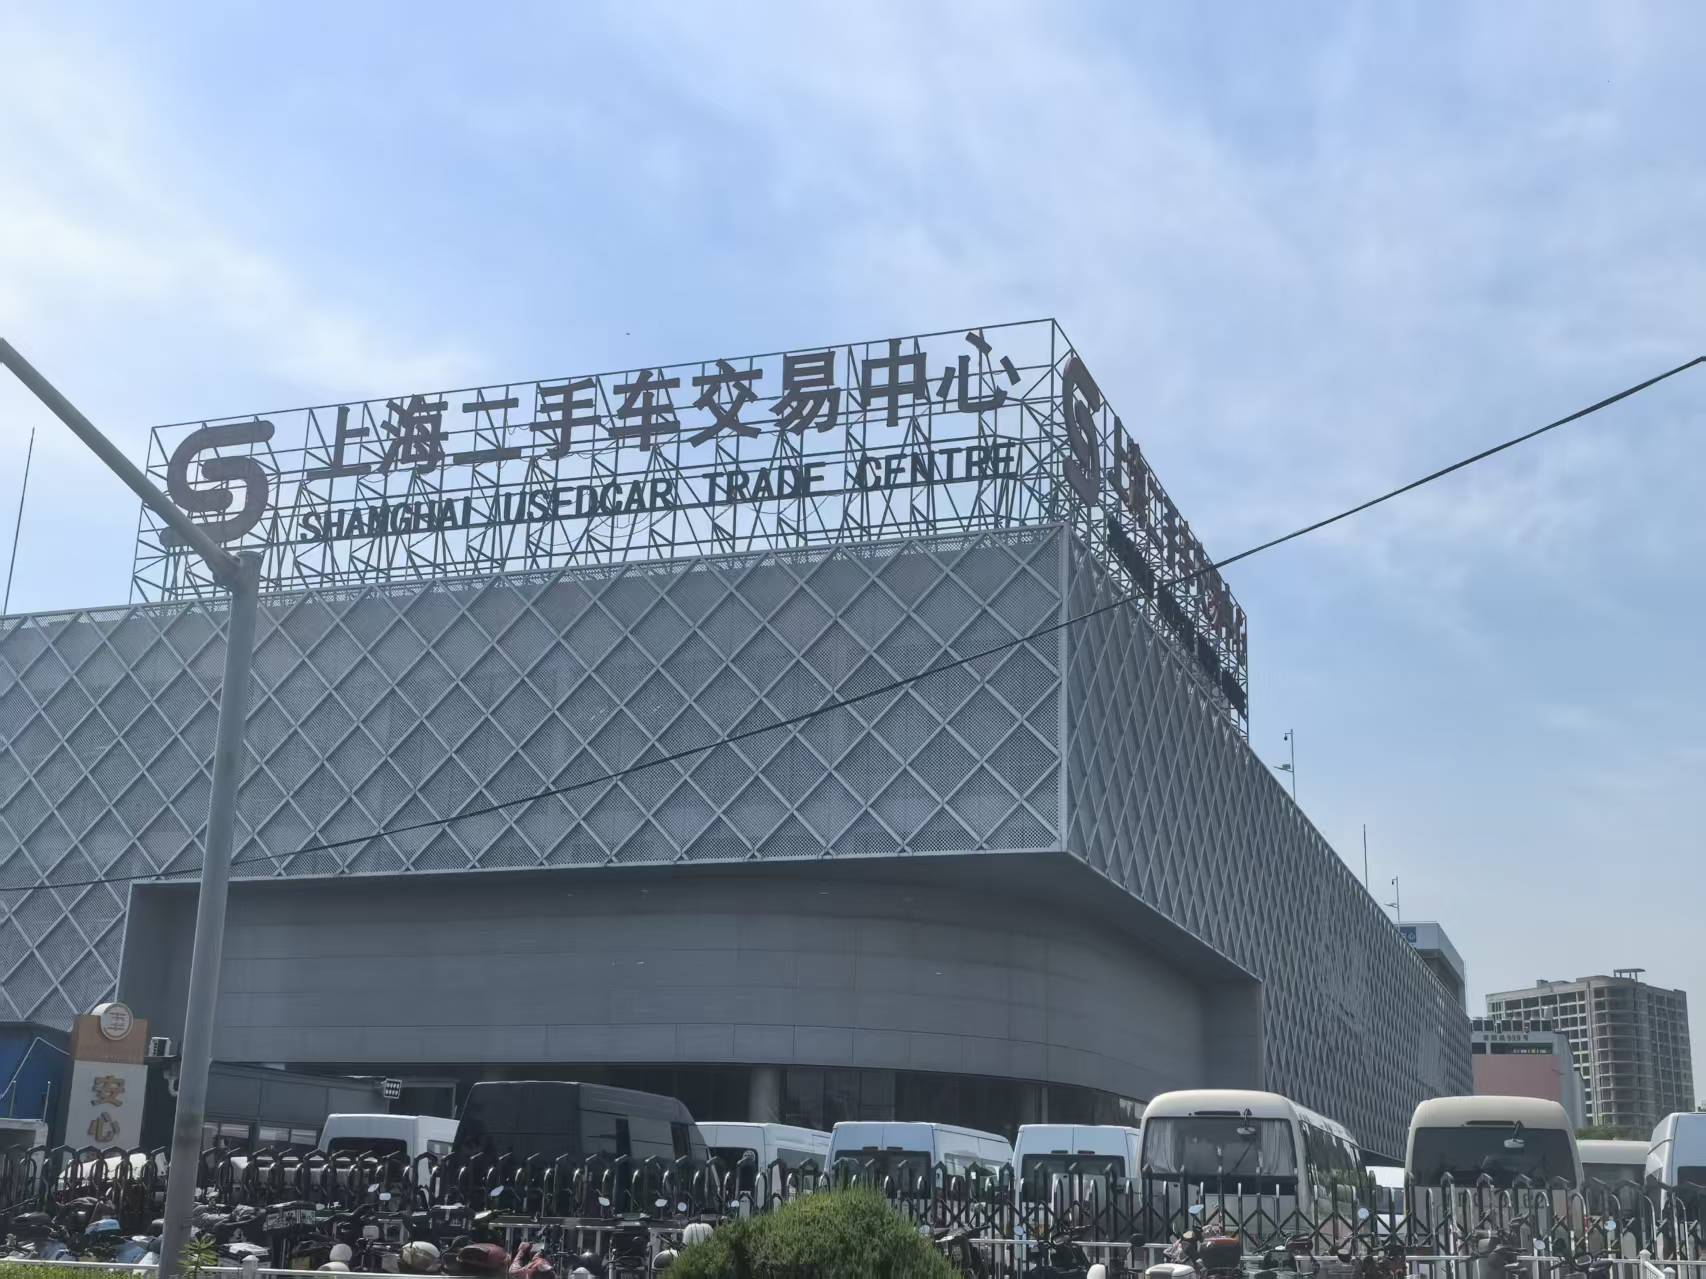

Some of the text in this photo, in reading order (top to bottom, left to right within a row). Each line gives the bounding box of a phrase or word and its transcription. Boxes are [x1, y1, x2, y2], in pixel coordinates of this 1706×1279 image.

[307, 331, 1021, 481] 上海二手车交易中心
[301, 496, 472, 541] SHANGHAI
[702, 461, 827, 502] TRADE
[857, 441, 1017, 491] CENTRE
